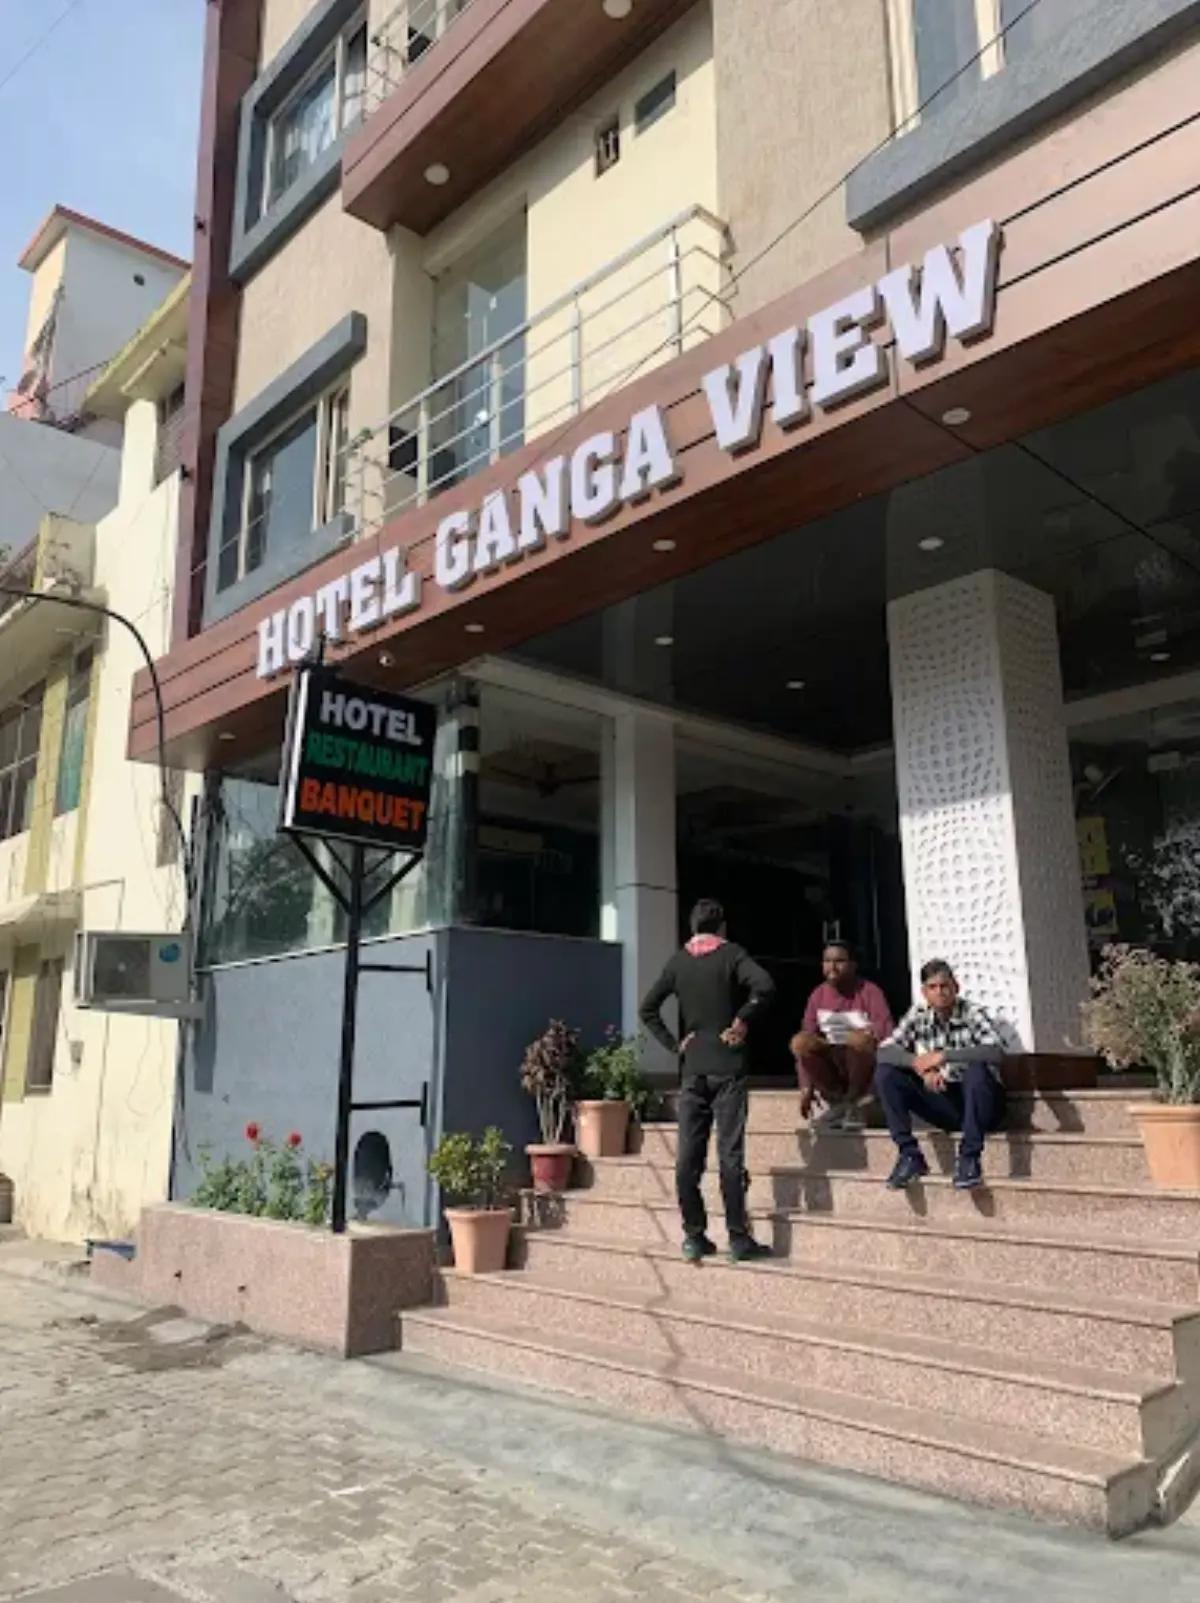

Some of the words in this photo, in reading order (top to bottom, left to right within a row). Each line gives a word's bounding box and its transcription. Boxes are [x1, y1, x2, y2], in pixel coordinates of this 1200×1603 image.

[256, 545, 419, 679] HOTEL
[434, 403, 675, 587] GANGA
[702, 217, 998, 452] VIEW
[320, 690, 423, 746] HOTEL
[306, 731, 429, 786] RESTAURANT
[301, 777, 426, 832] BANQUET
